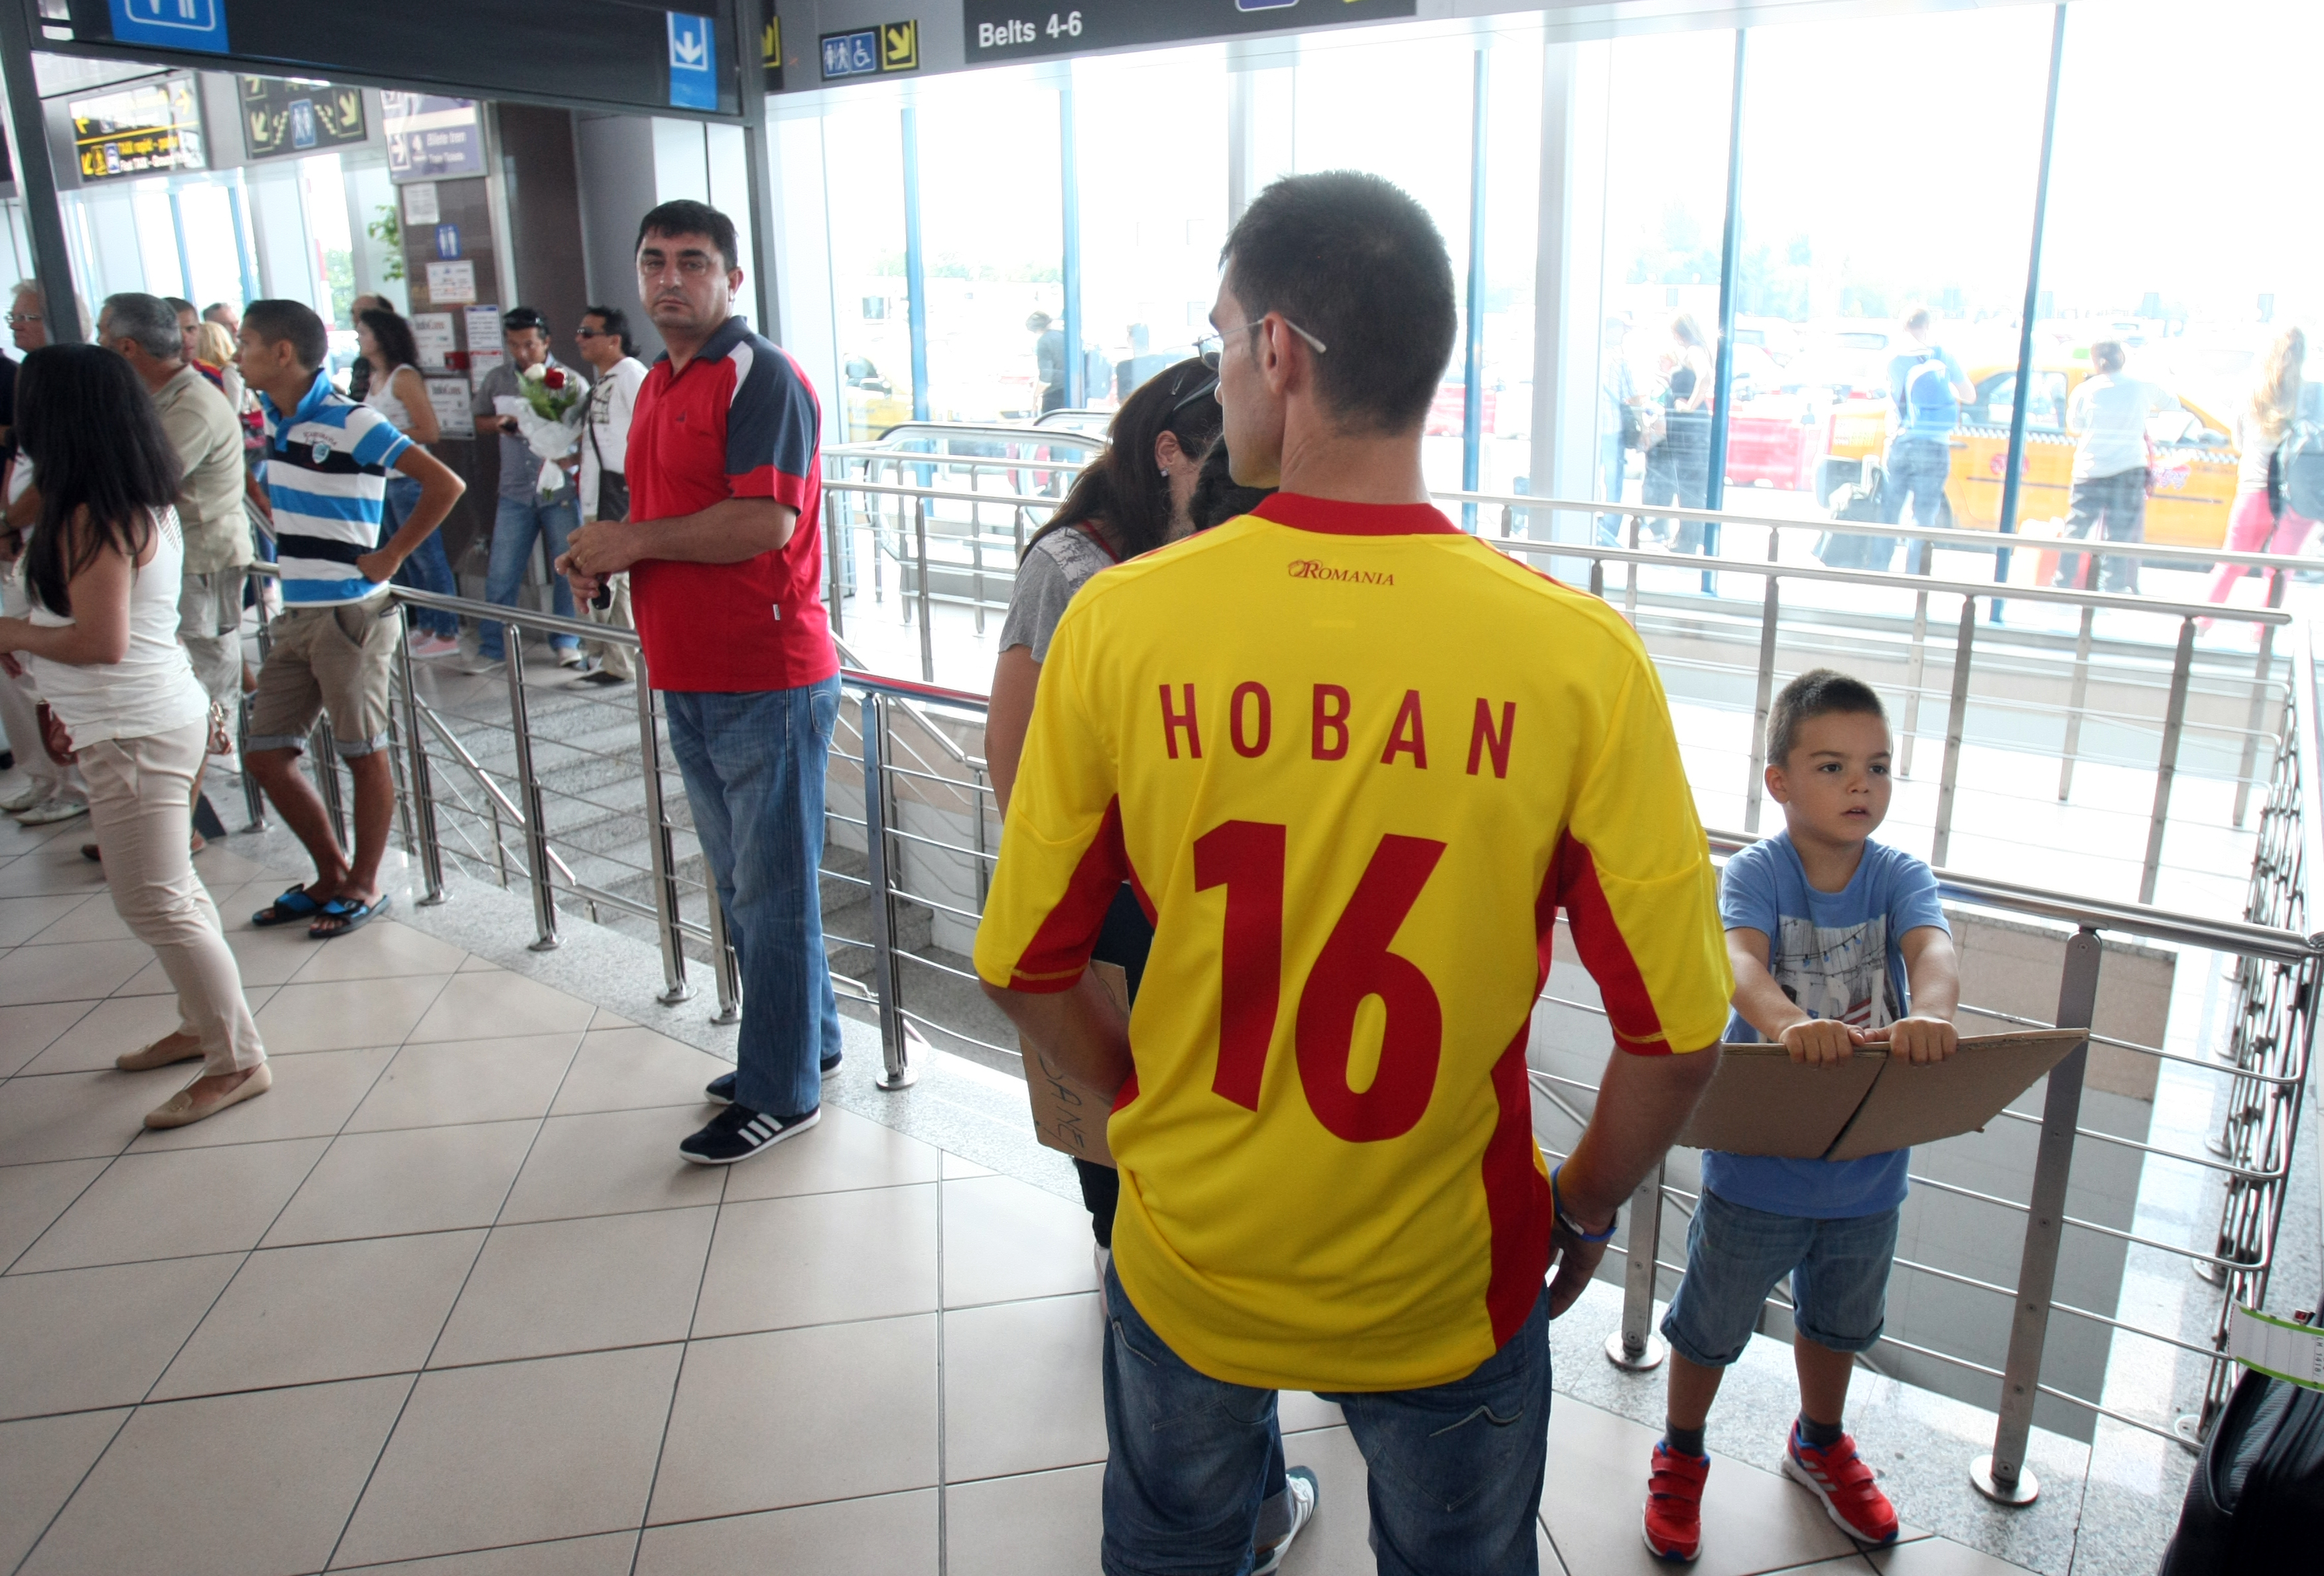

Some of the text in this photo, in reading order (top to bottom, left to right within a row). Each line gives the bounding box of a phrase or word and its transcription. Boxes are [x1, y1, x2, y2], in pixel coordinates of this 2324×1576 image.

[978, 11, 1082, 48] Belts 4-6
[1287, 559, 1395, 586] ROMANIA
[1159, 681, 1516, 779] HOBAN
[1193, 819, 1448, 1142] 16
